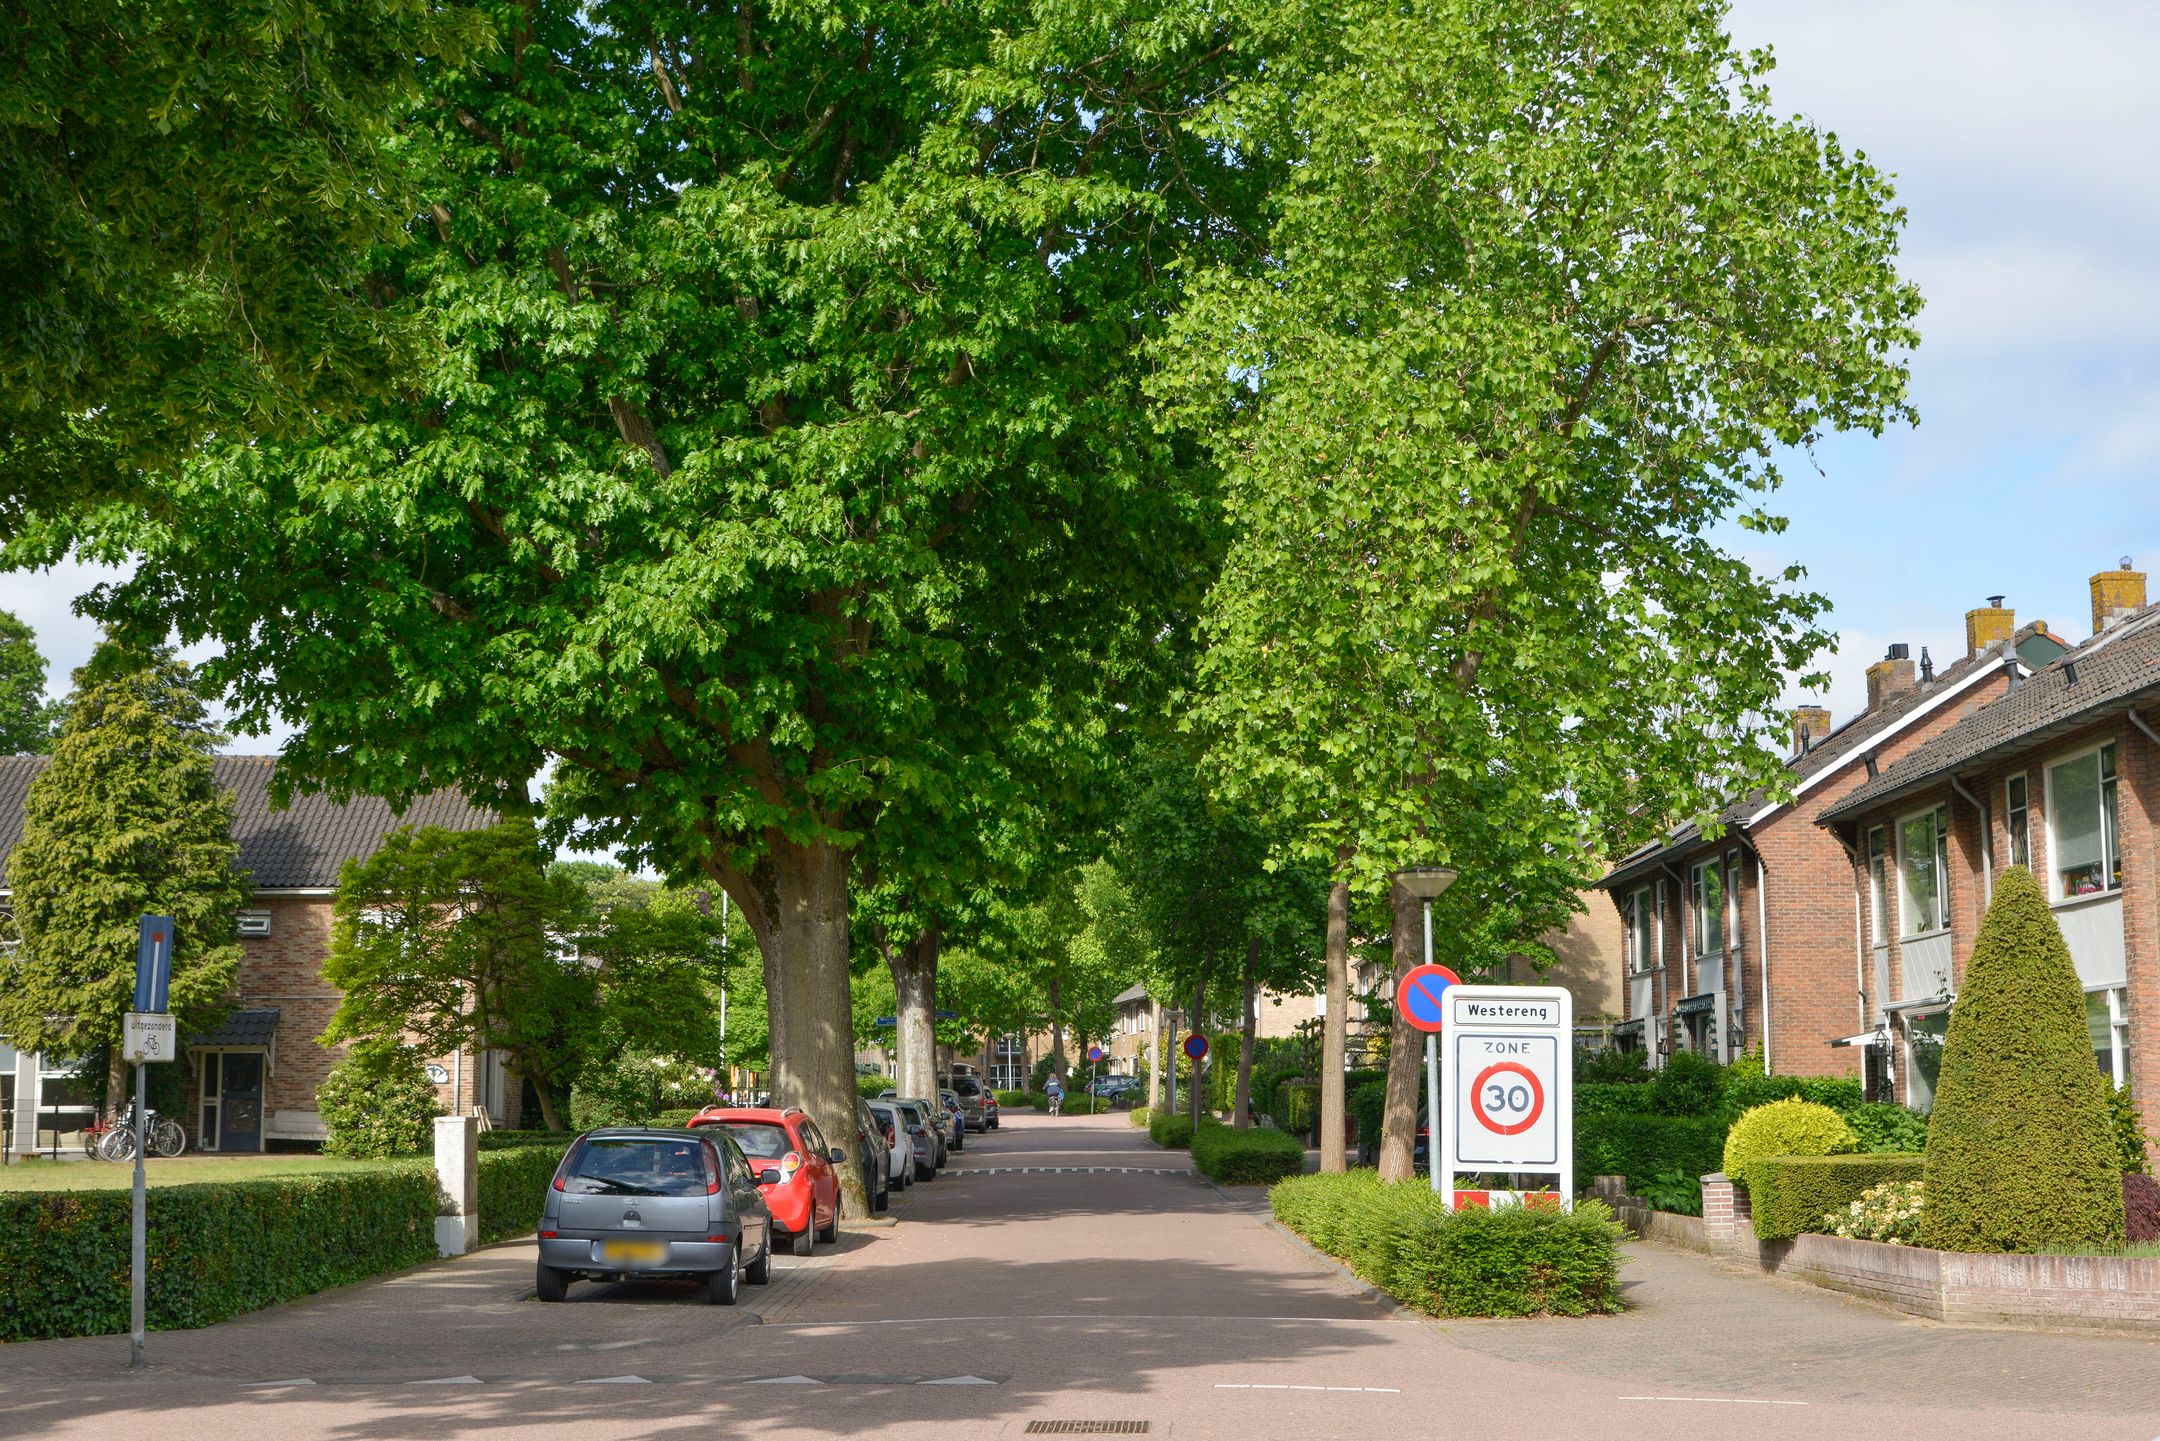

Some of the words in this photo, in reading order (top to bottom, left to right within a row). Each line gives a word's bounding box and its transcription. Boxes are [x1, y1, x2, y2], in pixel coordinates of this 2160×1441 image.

[1468, 1004, 1547, 1020] Westereng
[131, 1021, 171, 1032] uitgezonderd
[1483, 1042, 1530, 1054] ZONE
[1485, 1084, 1529, 1112] 30
